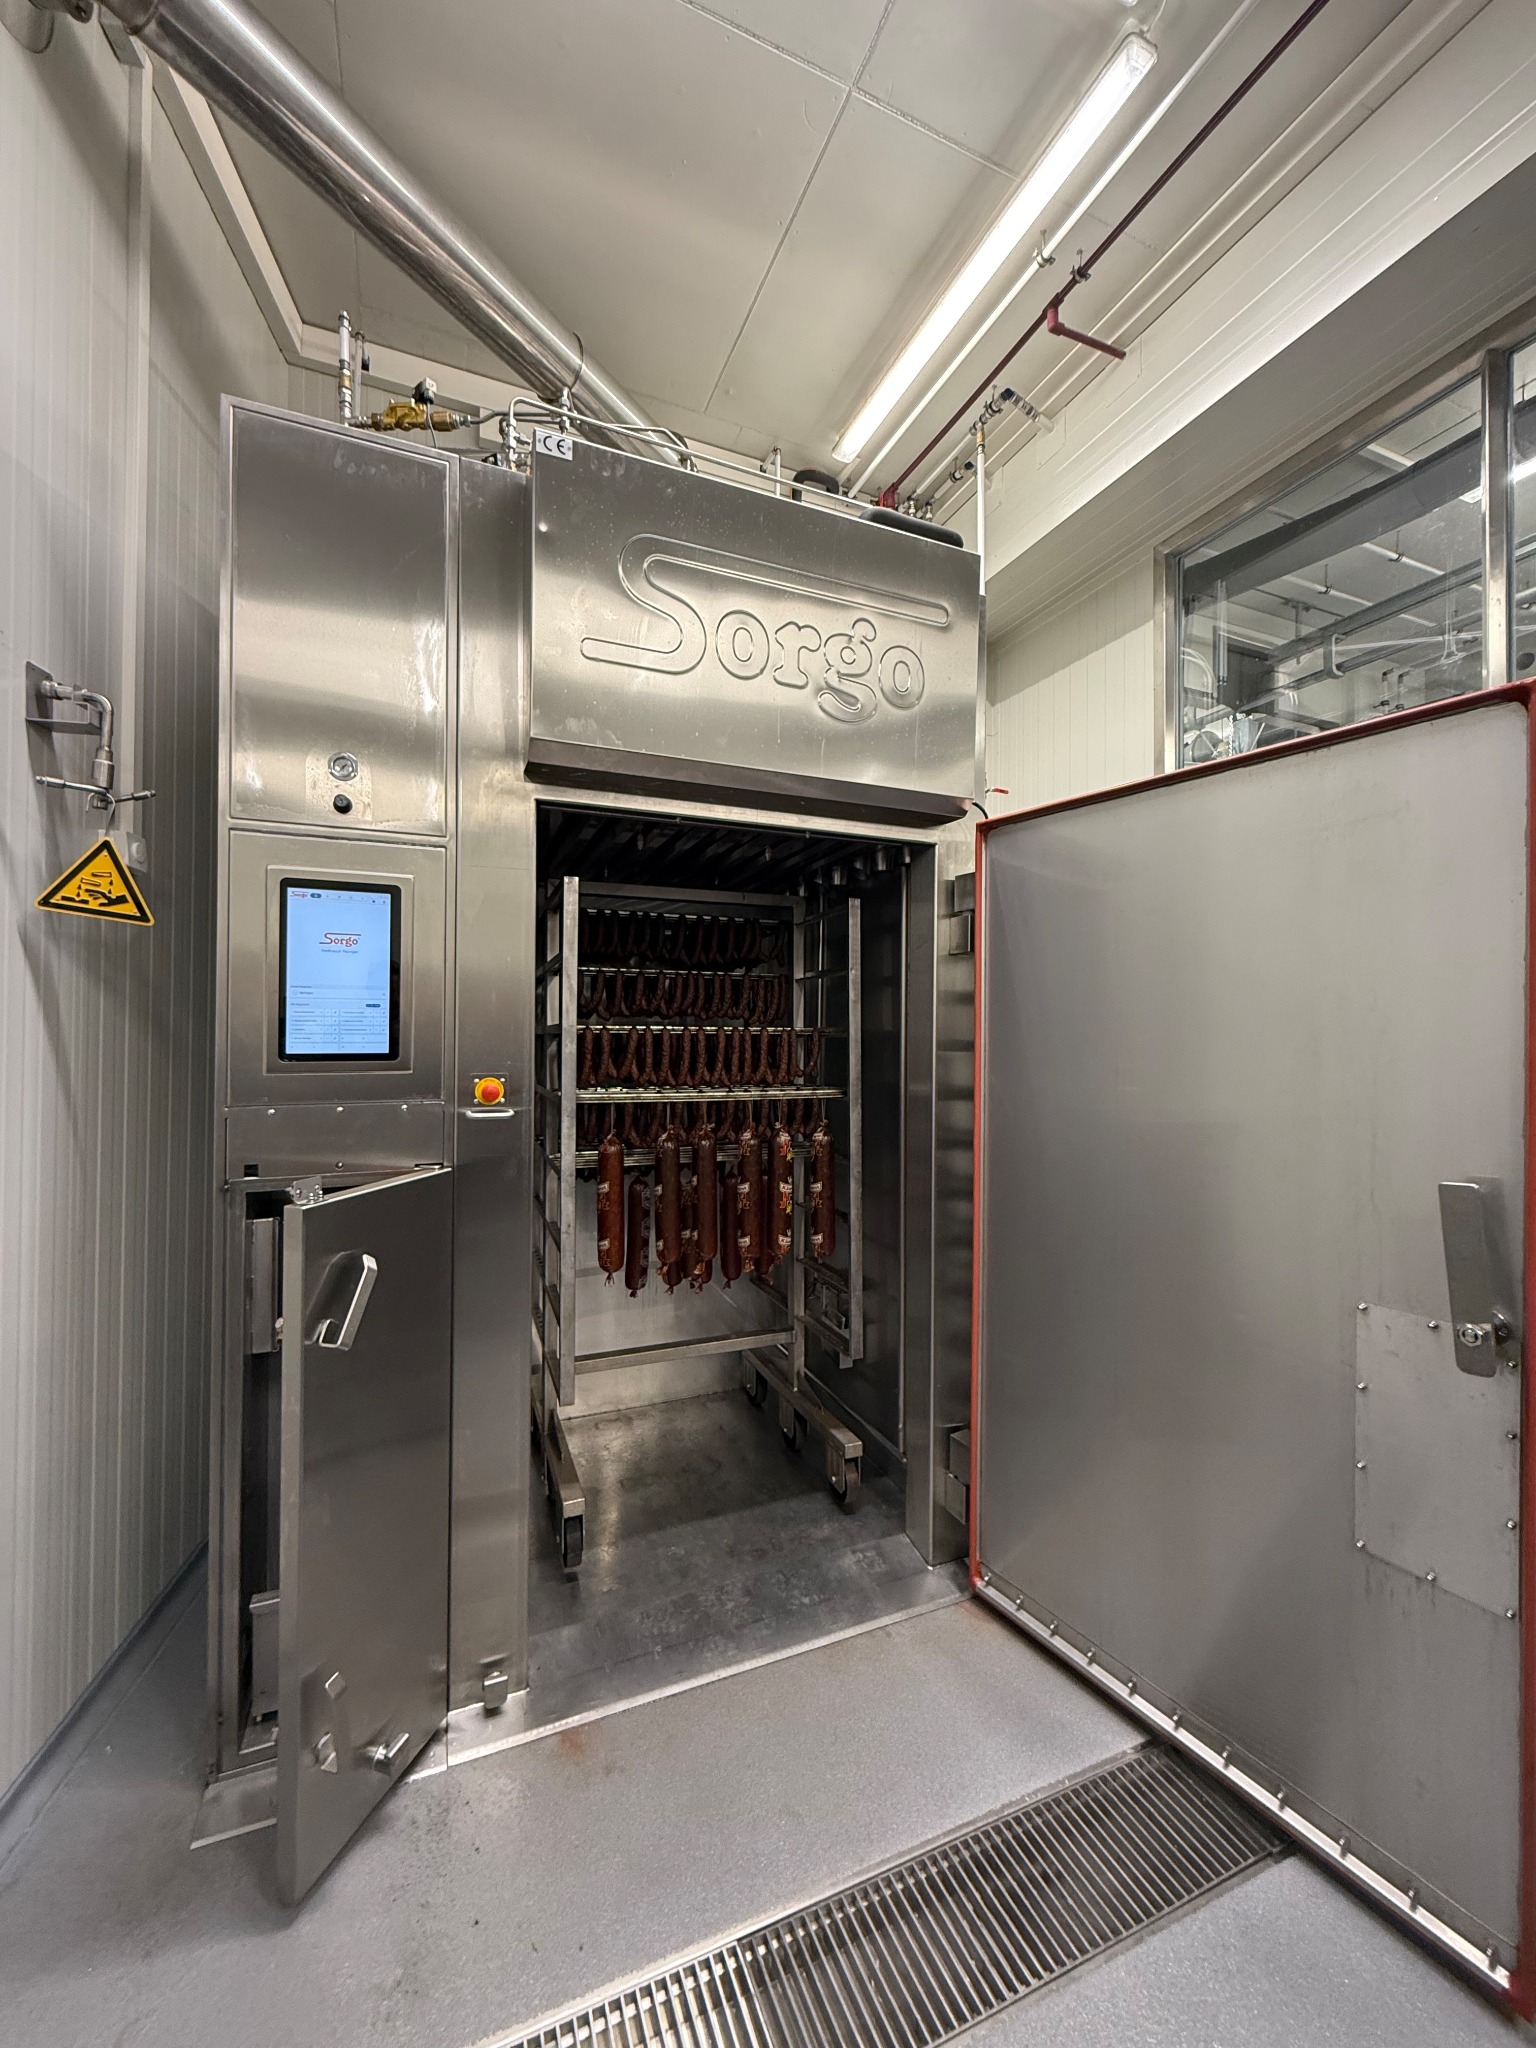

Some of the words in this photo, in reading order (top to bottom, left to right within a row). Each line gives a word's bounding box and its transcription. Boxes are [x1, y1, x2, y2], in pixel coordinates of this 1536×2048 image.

[543, 435, 566, 456] CE
[580, 533, 949, 724] Sorgo
[318, 932, 362, 948] Sorgo
